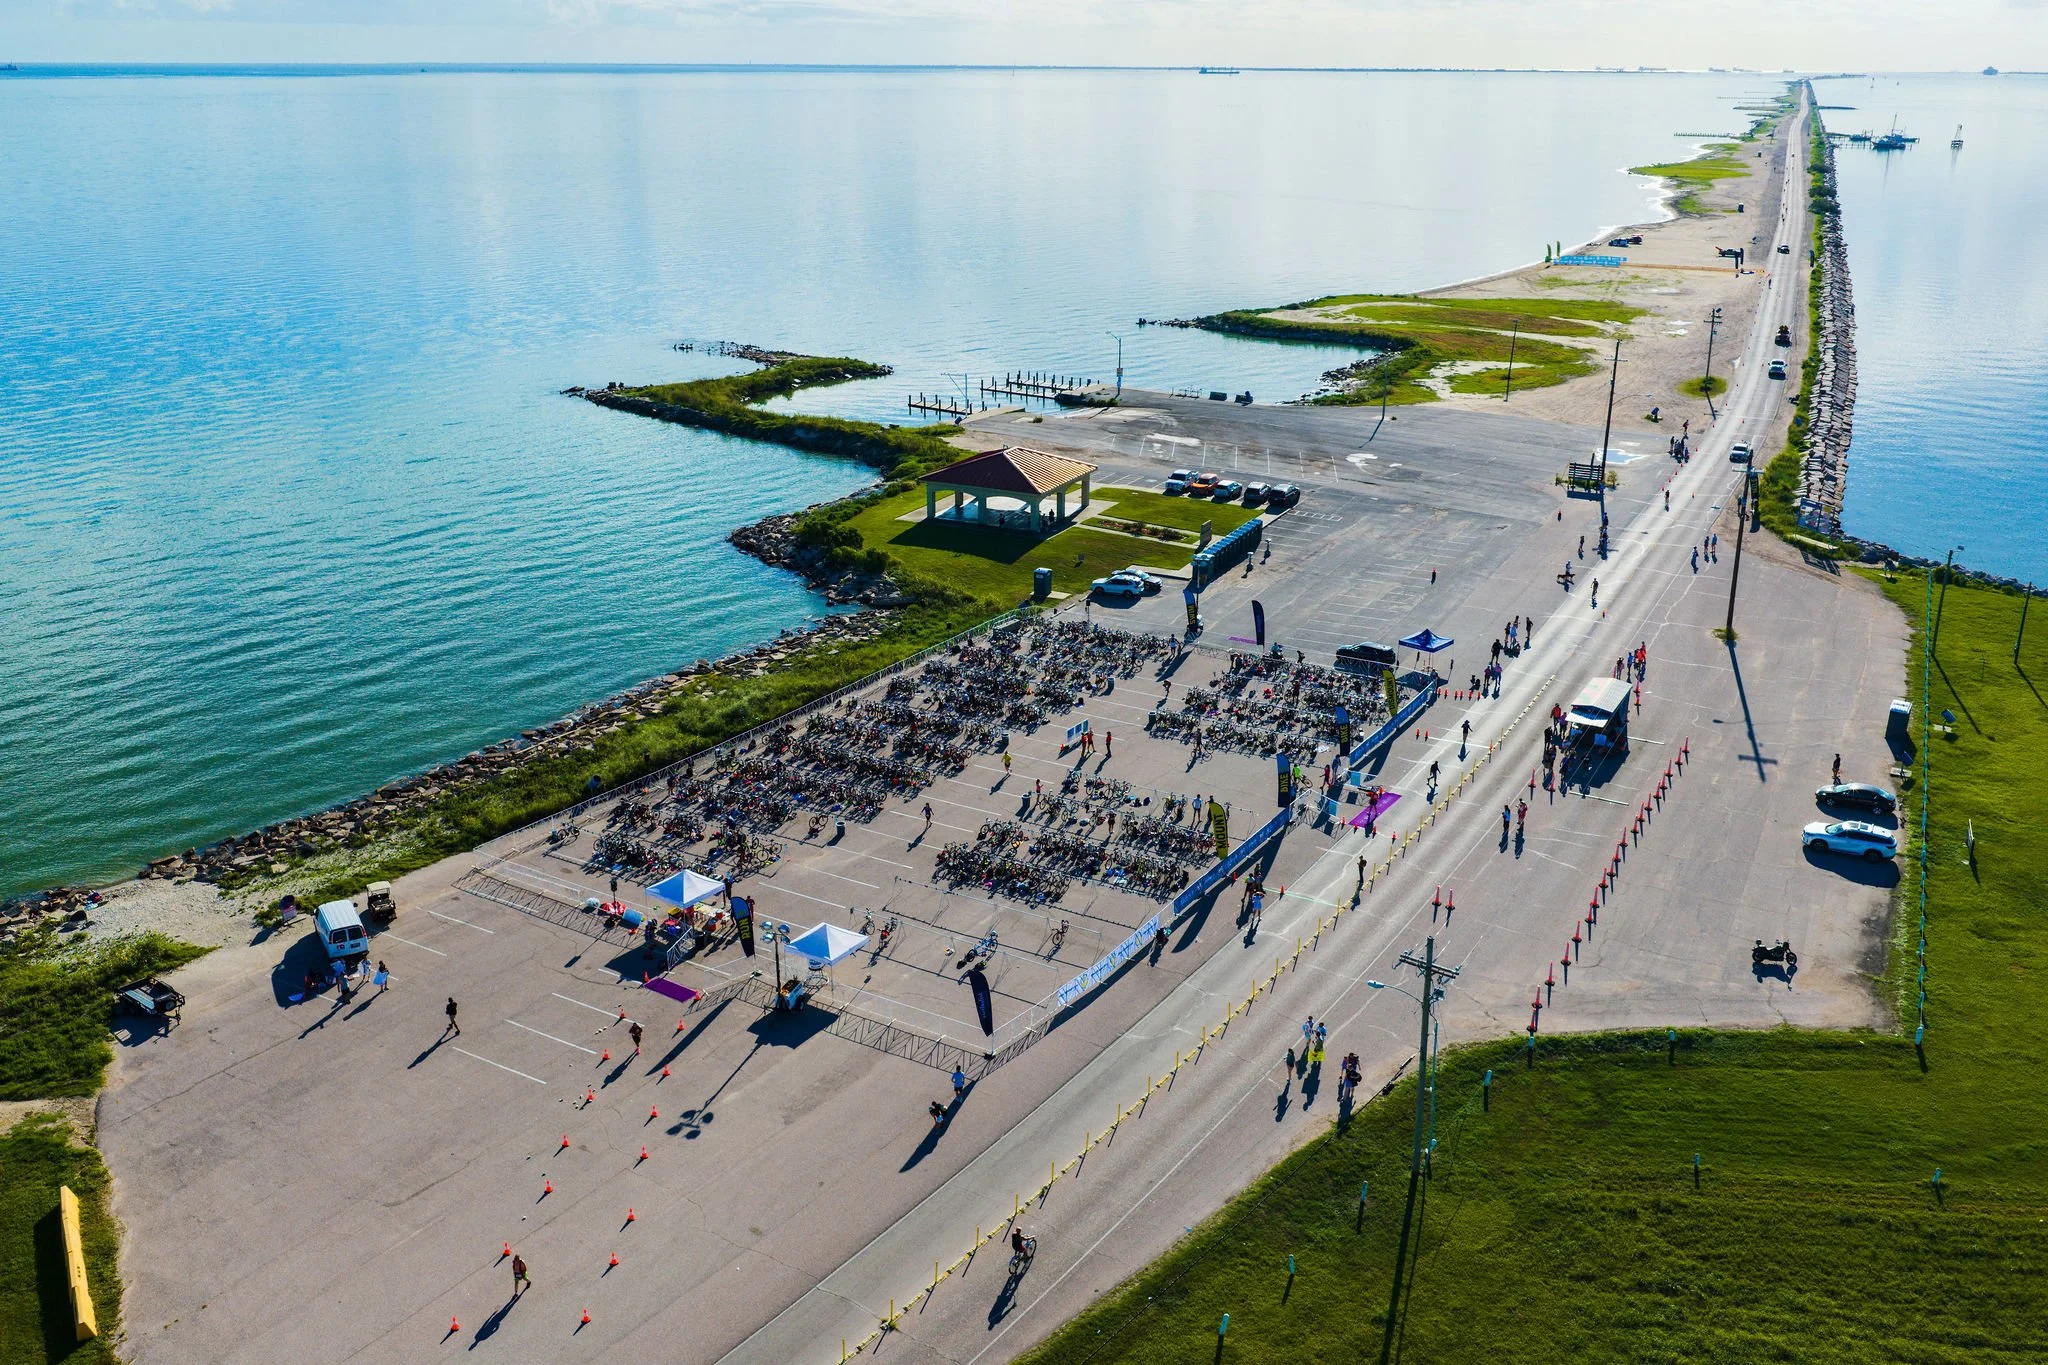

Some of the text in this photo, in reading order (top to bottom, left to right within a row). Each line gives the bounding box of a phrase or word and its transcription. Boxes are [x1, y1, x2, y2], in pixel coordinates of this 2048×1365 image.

[1188, 604, 1196, 625] SWIM
[1387, 676, 1395, 710] DISMOUNT
[1340, 724, 1348, 744] BIKE
[1280, 772, 1289, 793] BIKE
[1214, 813, 1226, 849] MOUNT
[739, 918, 751, 940] RUN
